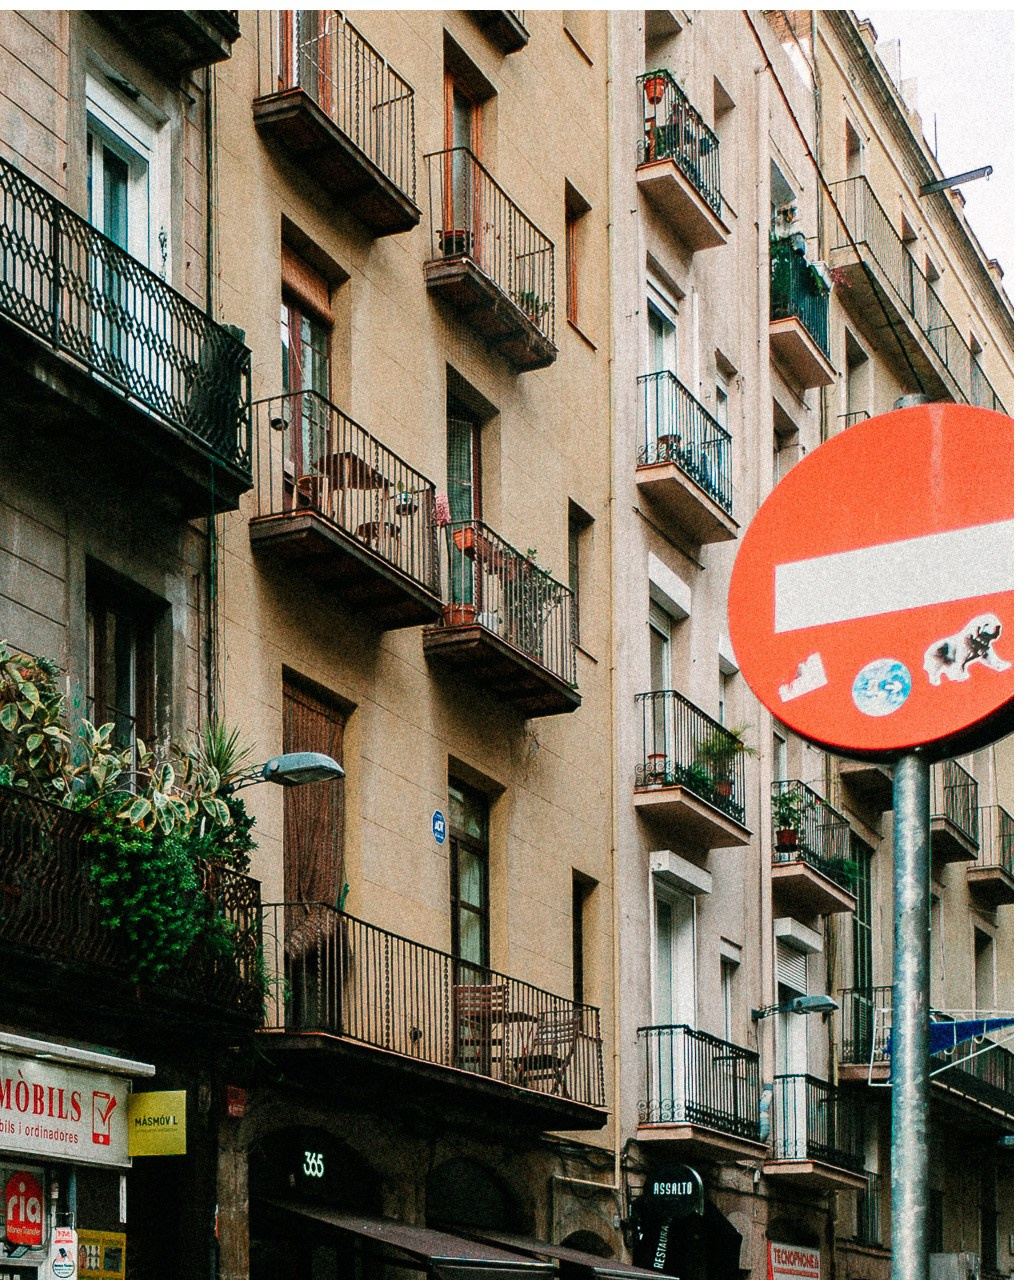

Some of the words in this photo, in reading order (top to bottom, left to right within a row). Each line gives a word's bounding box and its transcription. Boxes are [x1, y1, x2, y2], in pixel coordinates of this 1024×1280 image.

[18, 1121, 23, 1135] i
[25, 1124, 79, 1144] ordinadores
[303, 1151, 324, 1177] 365
[653, 1182, 693, 1195] ASSALTO
[7, 1181, 41, 1223] ria
[653, 1220, 672, 1269] RESTAURA
